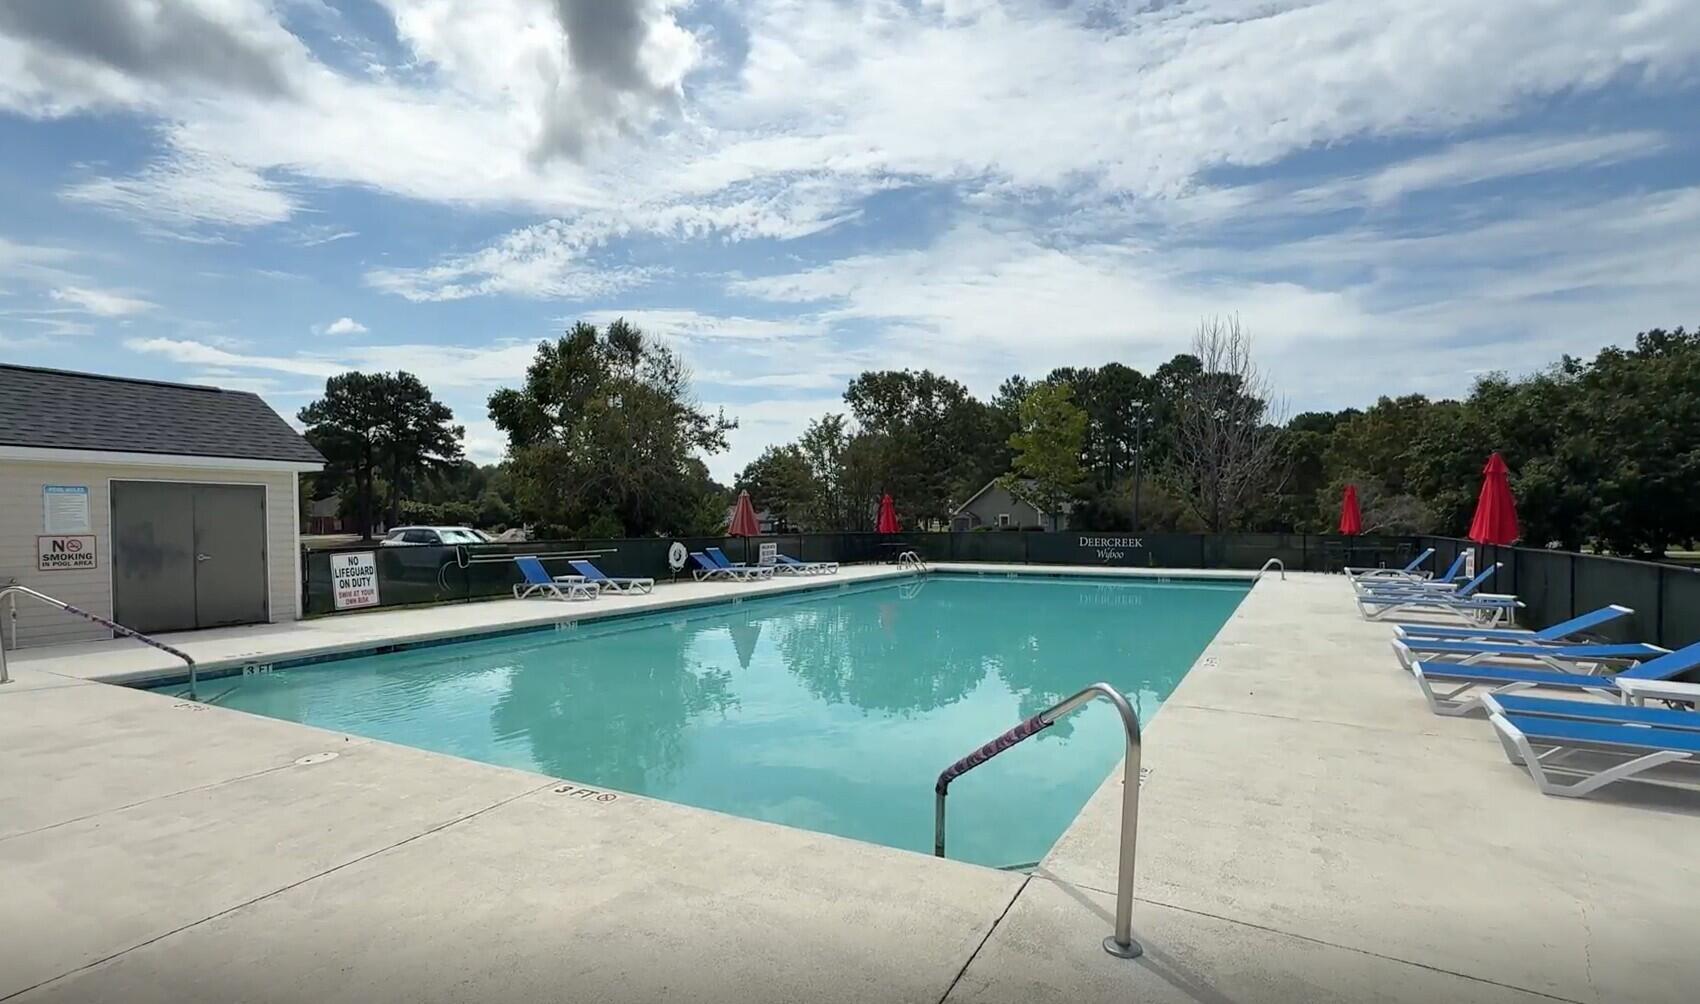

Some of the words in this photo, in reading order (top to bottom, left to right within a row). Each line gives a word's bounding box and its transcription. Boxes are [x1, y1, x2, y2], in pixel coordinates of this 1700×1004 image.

[1079, 536, 1143, 548] DEERCREEK
[42, 553, 93, 562] SMOKING
[1096, 547, 1125, 562] Wyboo
[348, 556, 359, 566] NO
[334, 566, 374, 578] LIFEGUARD
[339, 579, 350, 589] ON
[352, 577, 371, 588] DUTY
[247, 665, 255, 675] 3
[258, 664, 272, 673] FT
[554, 786, 573, 794] 3
[569, 789, 599, 799] FT
